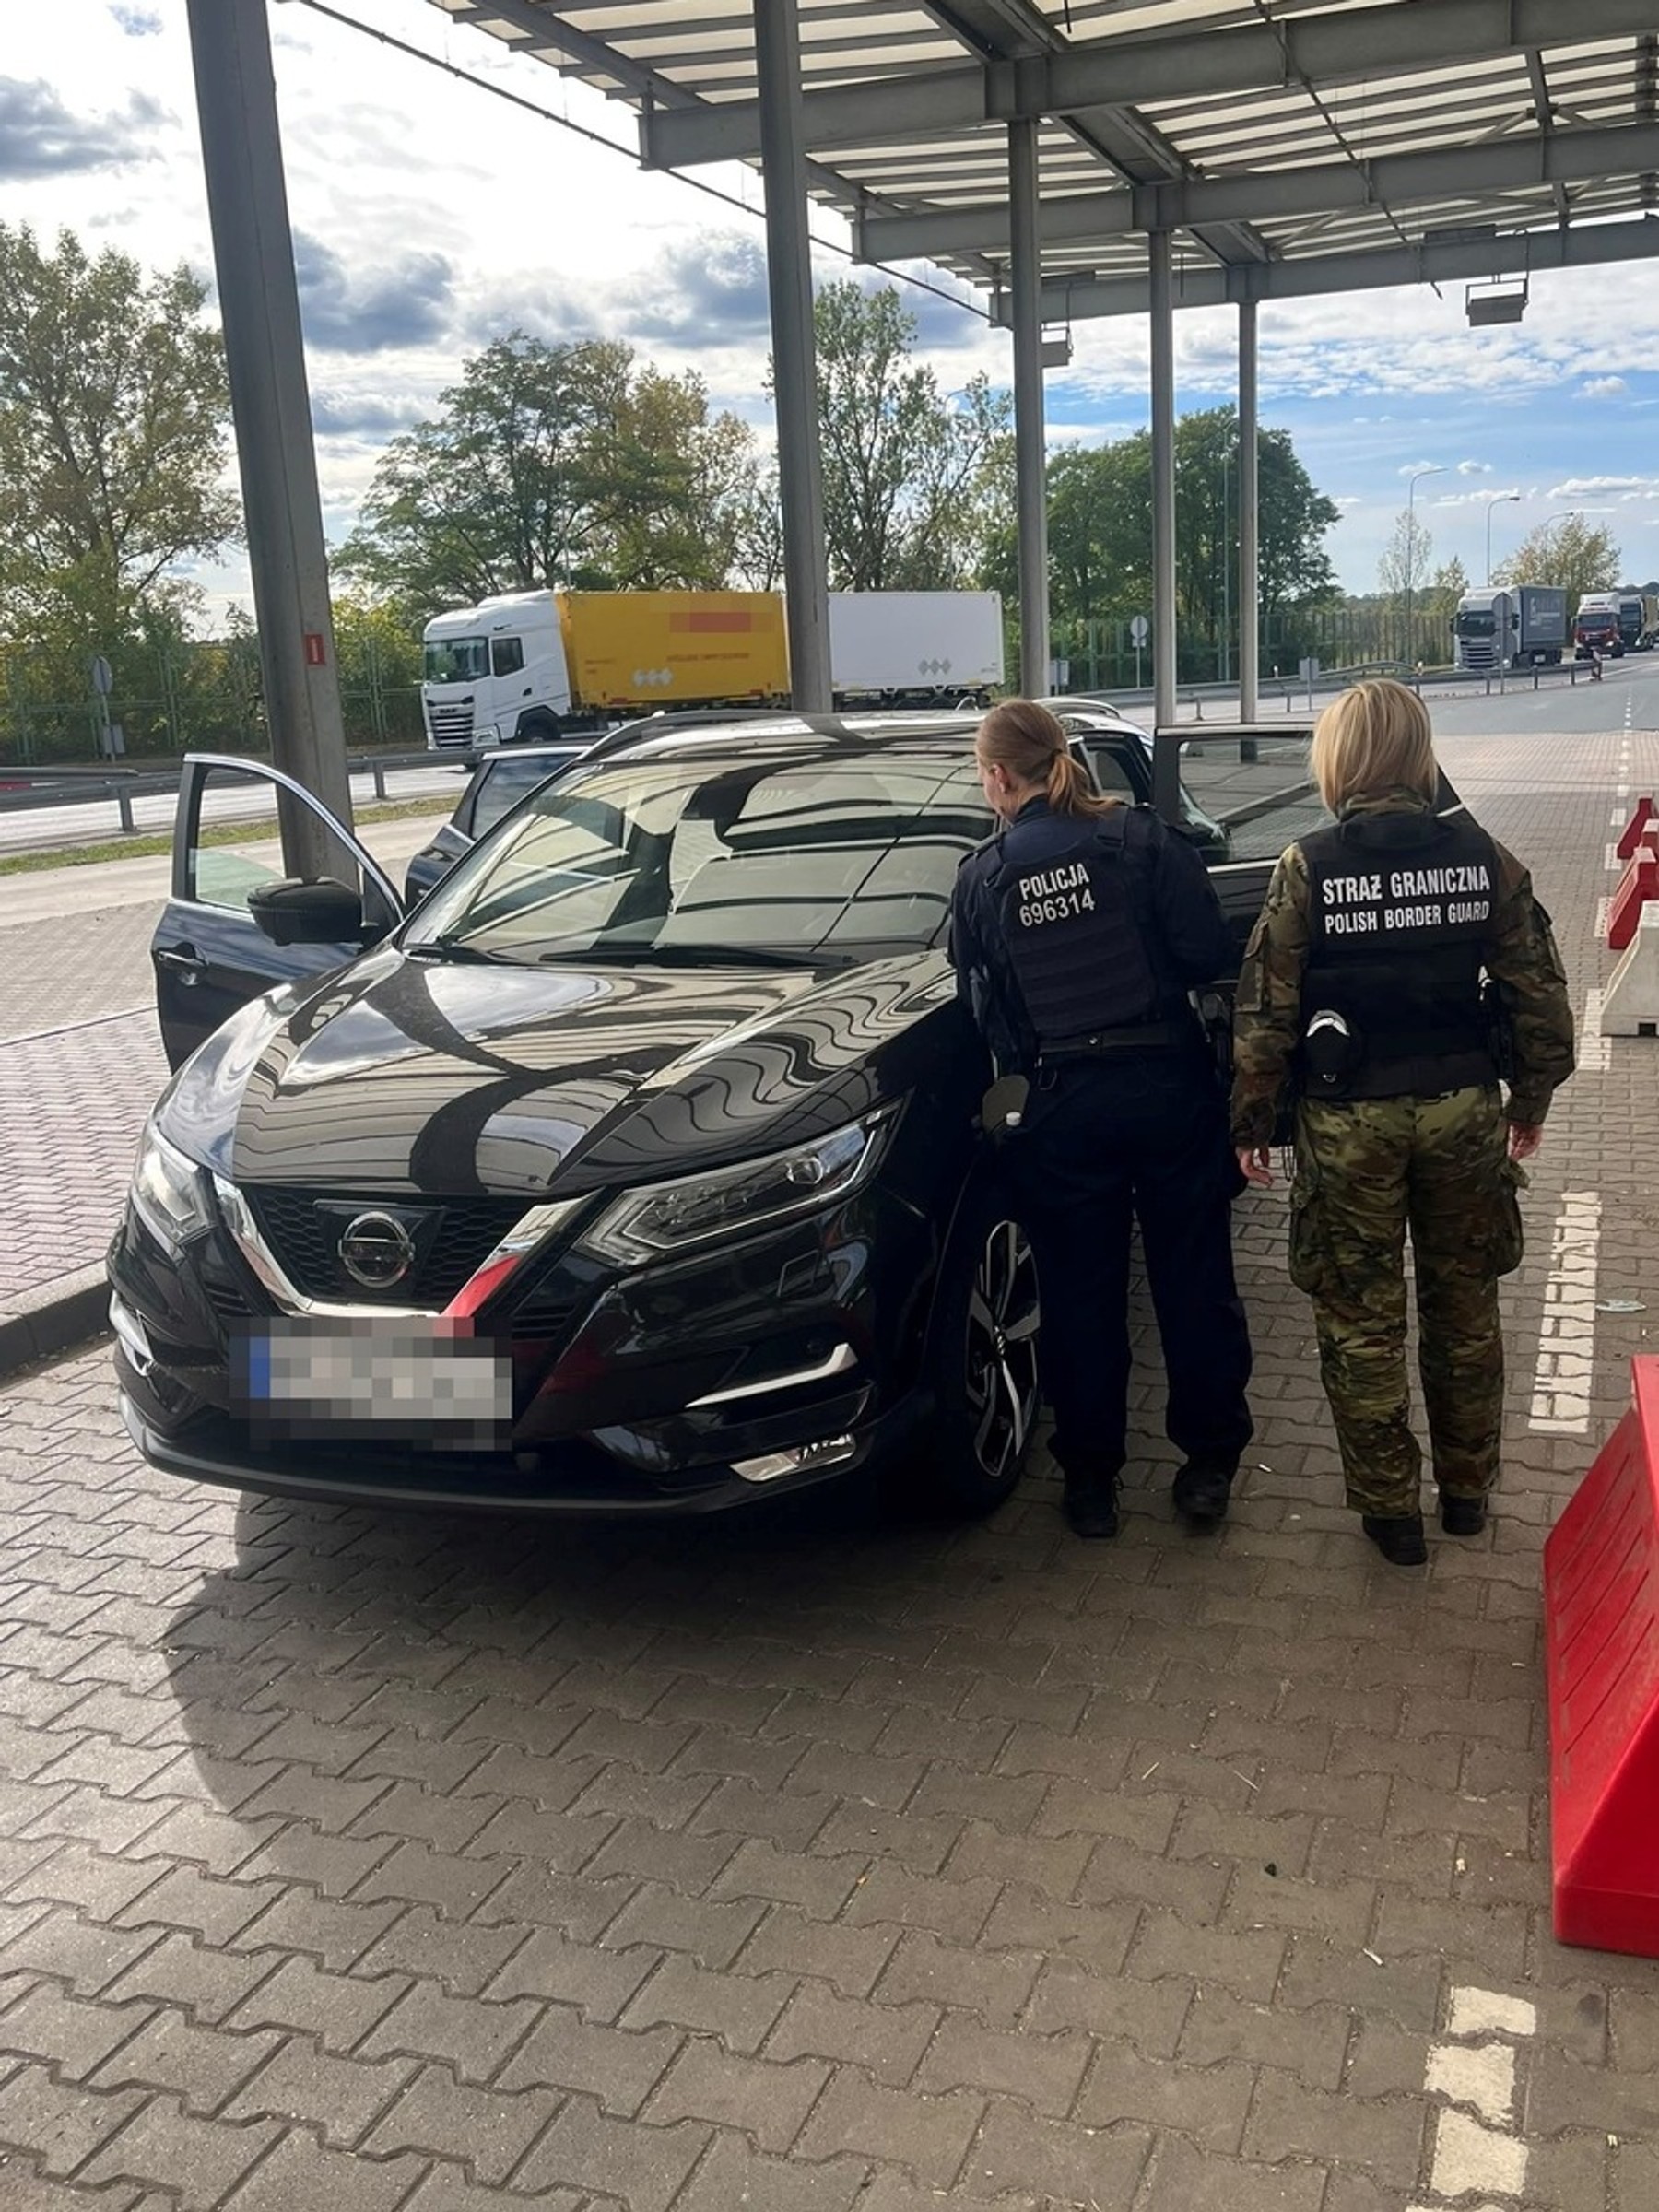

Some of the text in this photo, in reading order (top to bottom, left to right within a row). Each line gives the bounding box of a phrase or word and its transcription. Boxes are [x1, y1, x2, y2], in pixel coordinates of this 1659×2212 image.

[1018, 863, 1090, 901] POLICJA
[1390, 865, 1491, 898] GRANICZNA
[1018, 888, 1095, 927] 696314
[1324, 900, 1490, 935] POLISH BORDER GUARD
